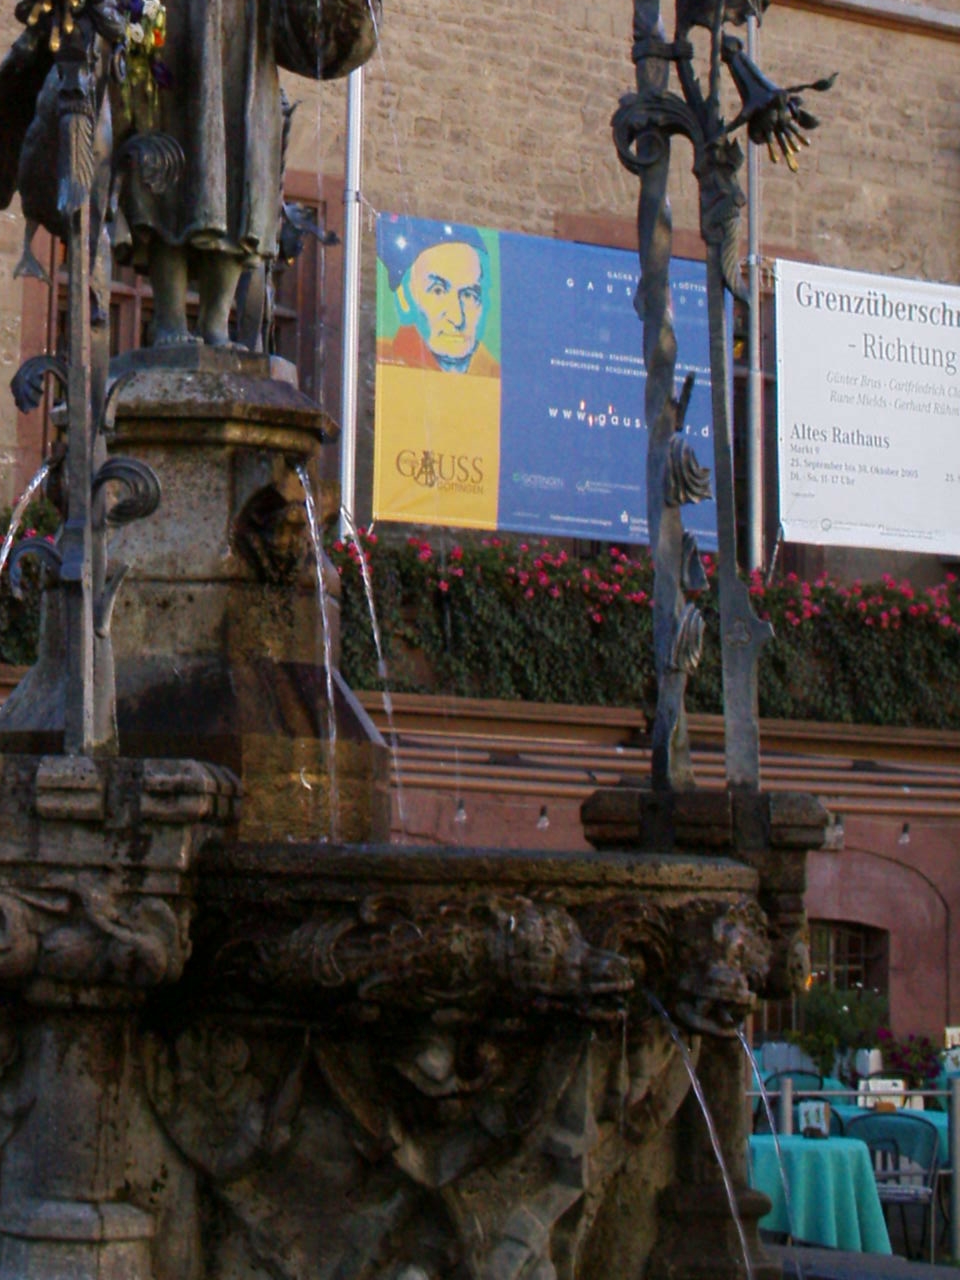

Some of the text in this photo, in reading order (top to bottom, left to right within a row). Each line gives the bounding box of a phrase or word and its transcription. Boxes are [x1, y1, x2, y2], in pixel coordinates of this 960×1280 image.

[863, 332, 957, 377] Richtung
[790, 422, 890, 450] Altes Rathaus
[395, 448, 484, 488] GAUSS
